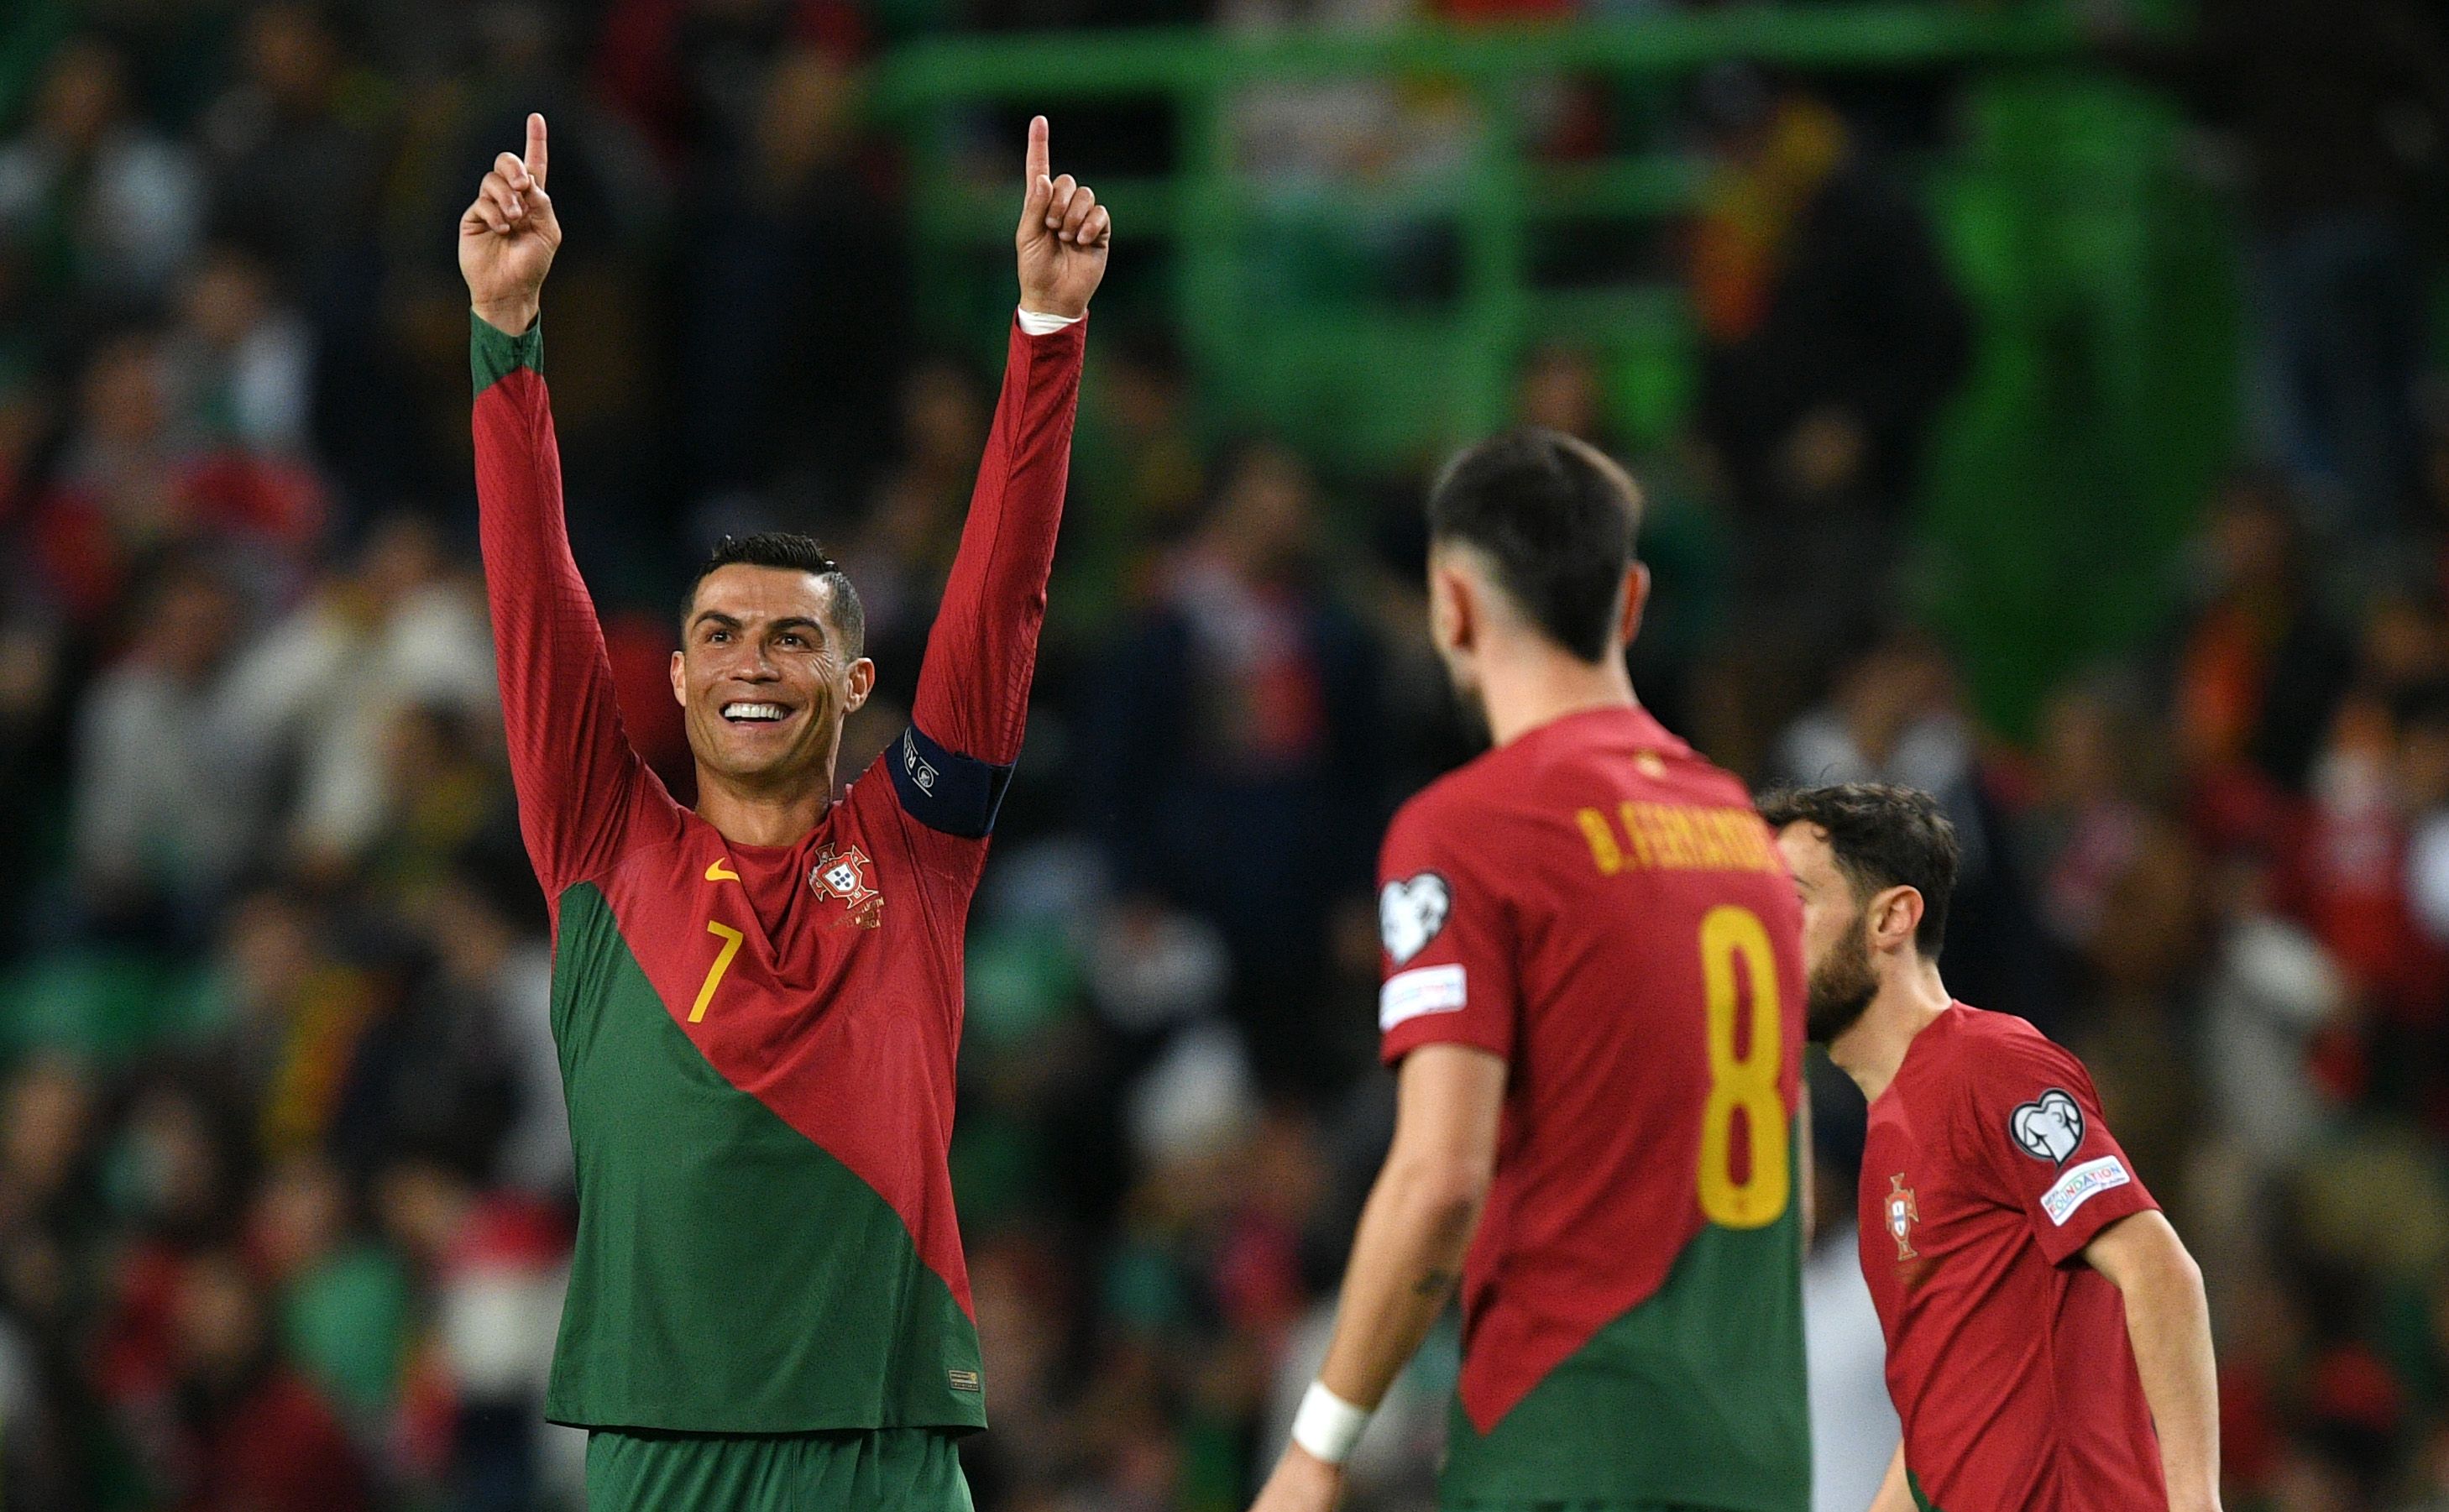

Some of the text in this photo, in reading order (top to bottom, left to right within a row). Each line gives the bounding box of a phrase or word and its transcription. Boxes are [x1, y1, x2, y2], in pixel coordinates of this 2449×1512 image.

[687, 919, 744, 1023] 7
[1698, 904, 1789, 1229] 8
[2048, 1167, 2121, 1215] FOUNDATION
